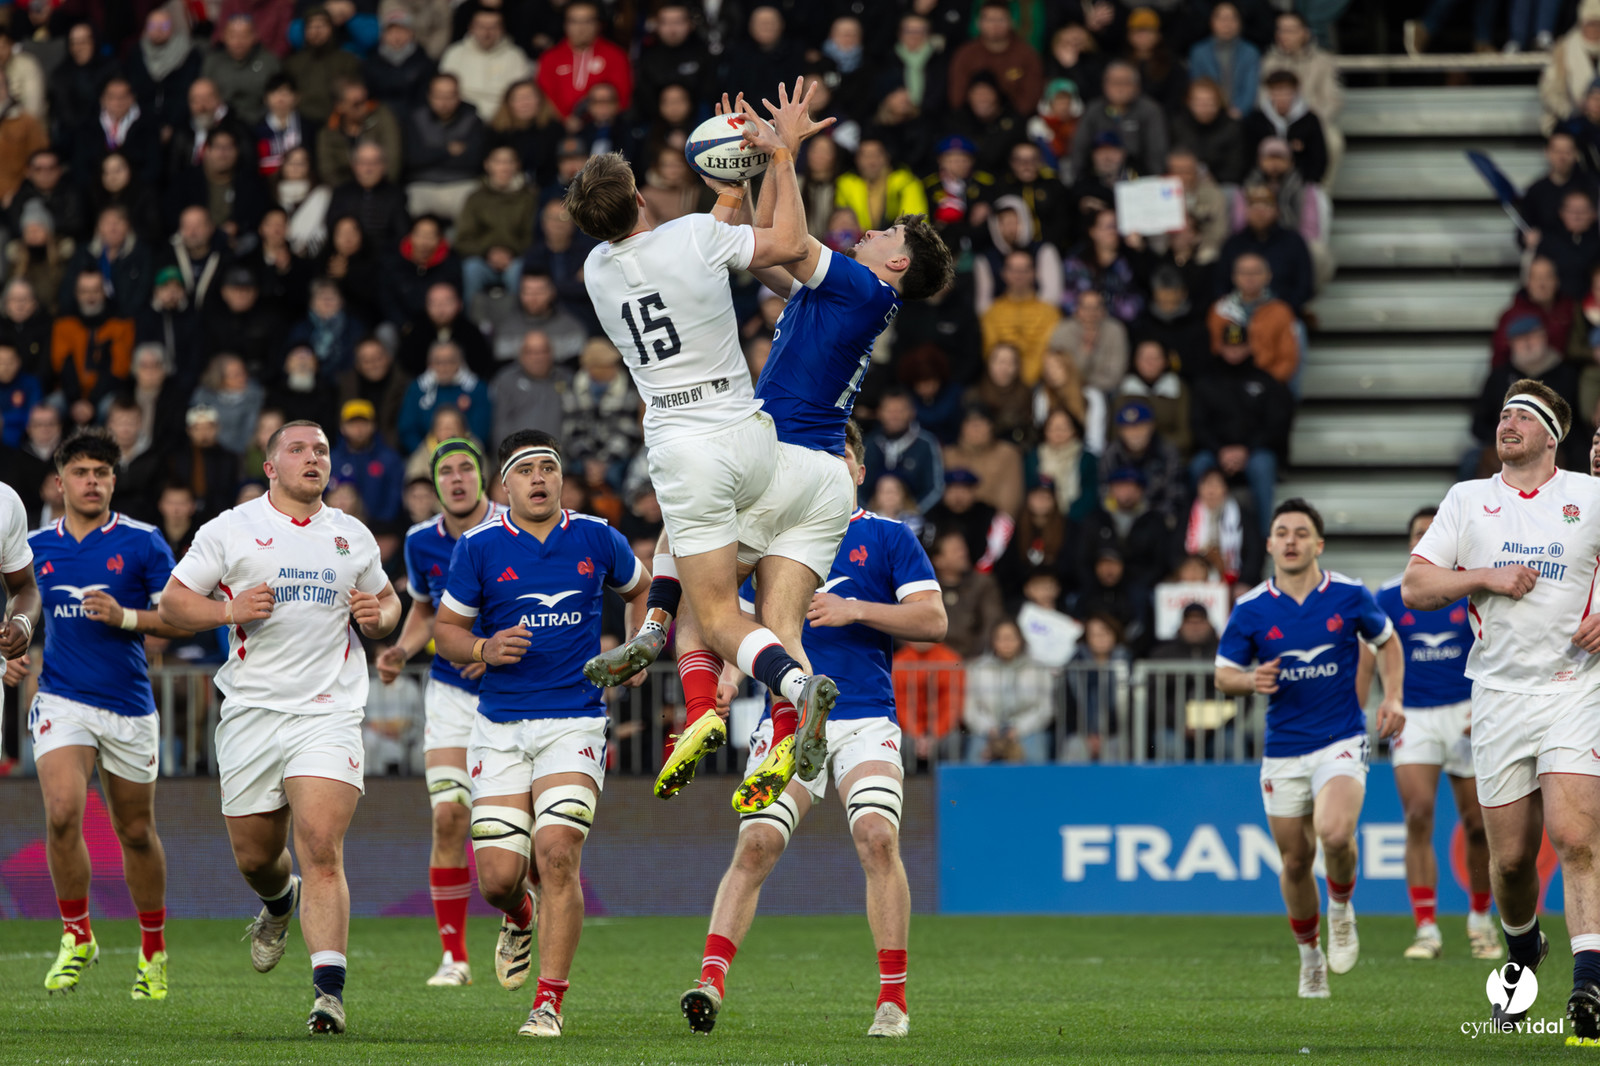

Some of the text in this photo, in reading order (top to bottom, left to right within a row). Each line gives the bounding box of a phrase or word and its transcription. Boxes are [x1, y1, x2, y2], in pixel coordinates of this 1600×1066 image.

[704, 153, 770, 169] ILBERT
[622, 292, 681, 365] 15
[690, 386, 703, 402] BY
[1501, 541, 1545, 555] Allianz
[278, 567, 319, 580] Allianz
[273, 585, 338, 606] KICK START
[518, 611, 582, 627] ALTRAD
[1411, 646, 1462, 662] ALTRAD
[1279, 662, 1338, 681] ALTRAD
[1060, 824, 1408, 882] FRANE
